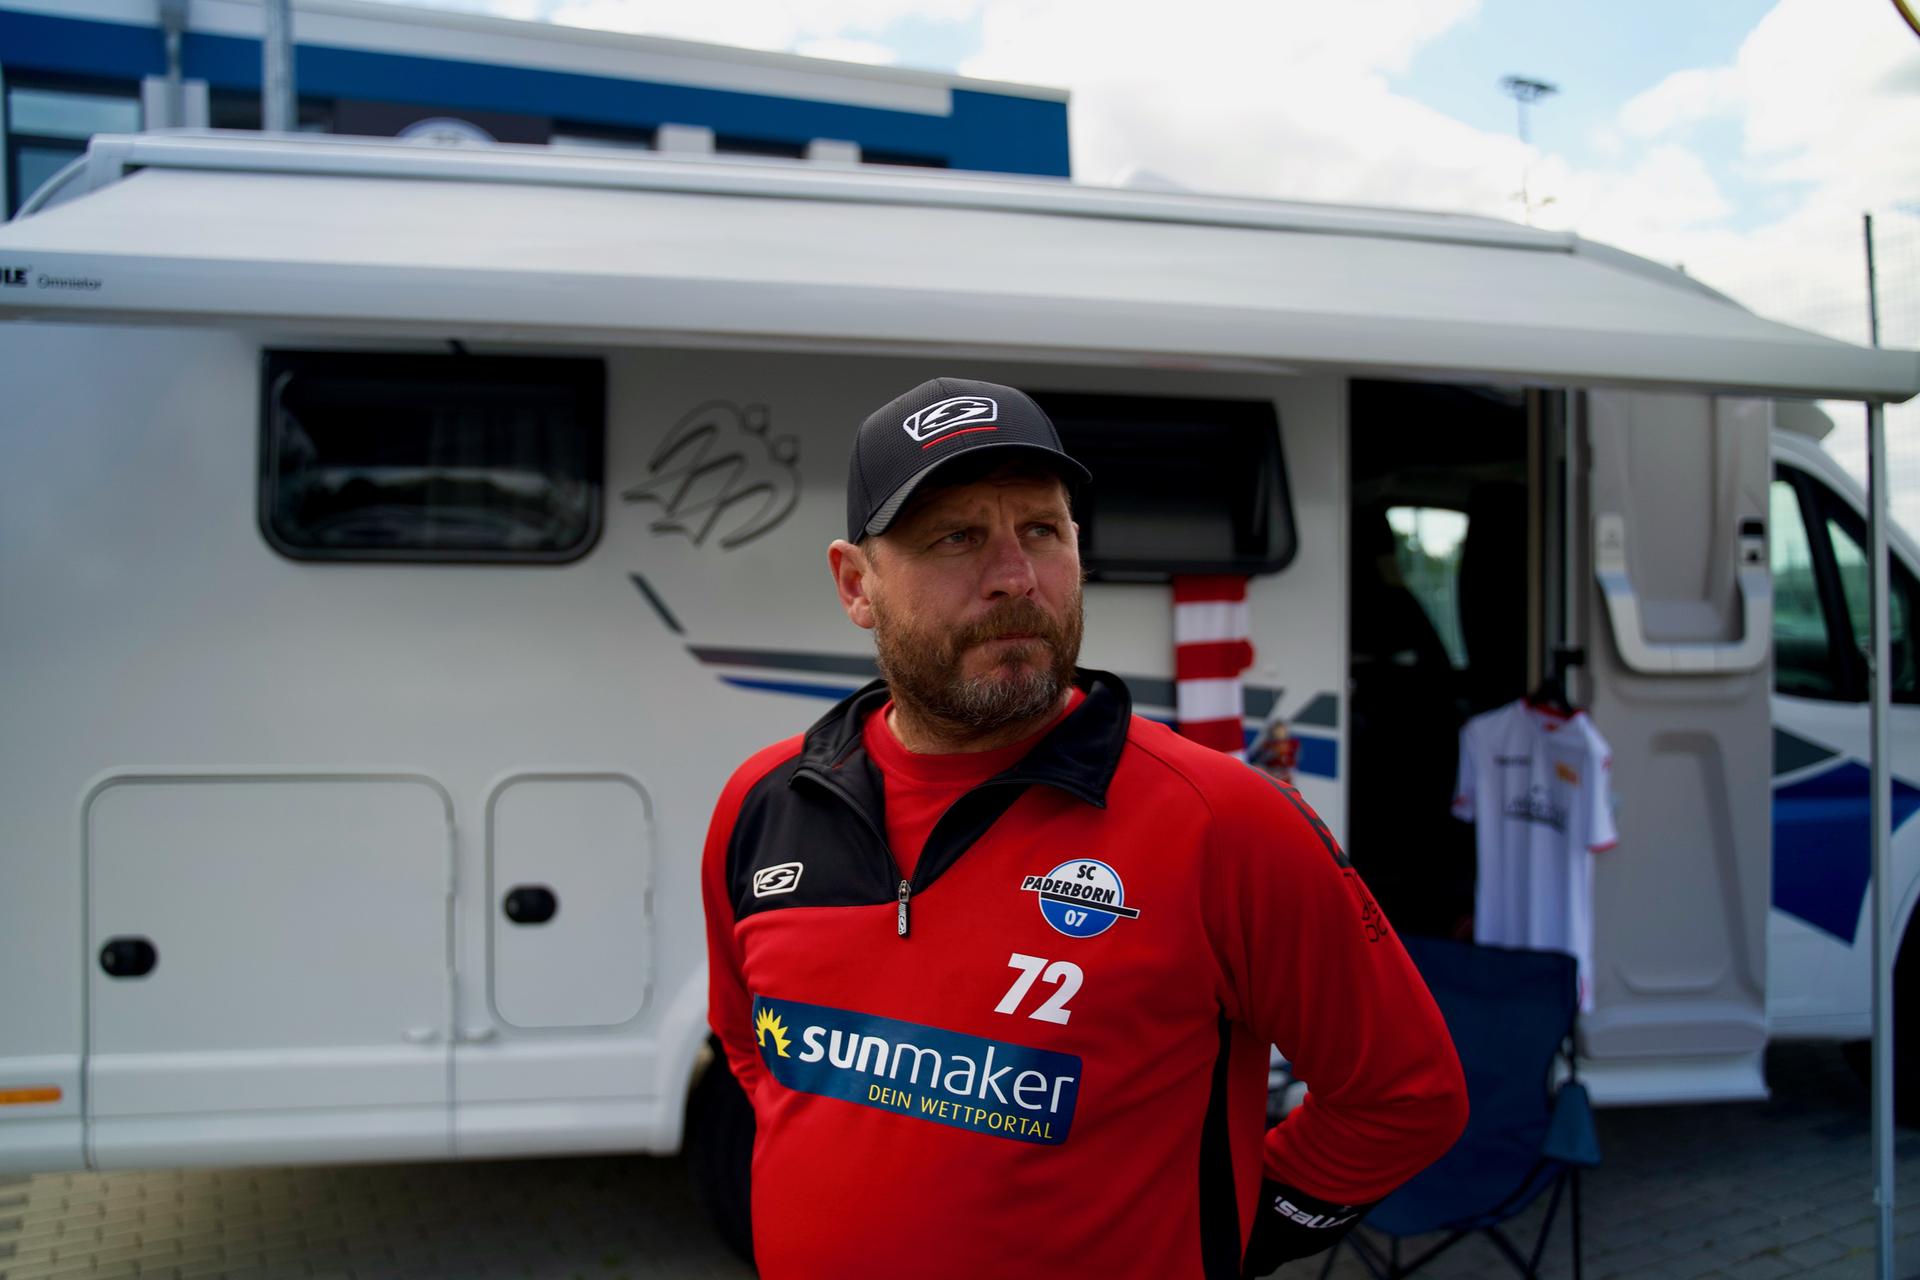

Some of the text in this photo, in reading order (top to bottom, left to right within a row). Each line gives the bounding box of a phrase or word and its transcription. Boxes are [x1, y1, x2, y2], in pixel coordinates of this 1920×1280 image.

[0, 267, 28, 288] LE
[1076, 864, 1096, 880] SC
[1023, 876, 1115, 904] PADERBORN
[1064, 909, 1088, 927] 07
[994, 952, 1084, 1025] 72
[799, 1025, 1075, 1113] sunmaker
[868, 1084, 1053, 1139] DEIN WETTPORTAL
